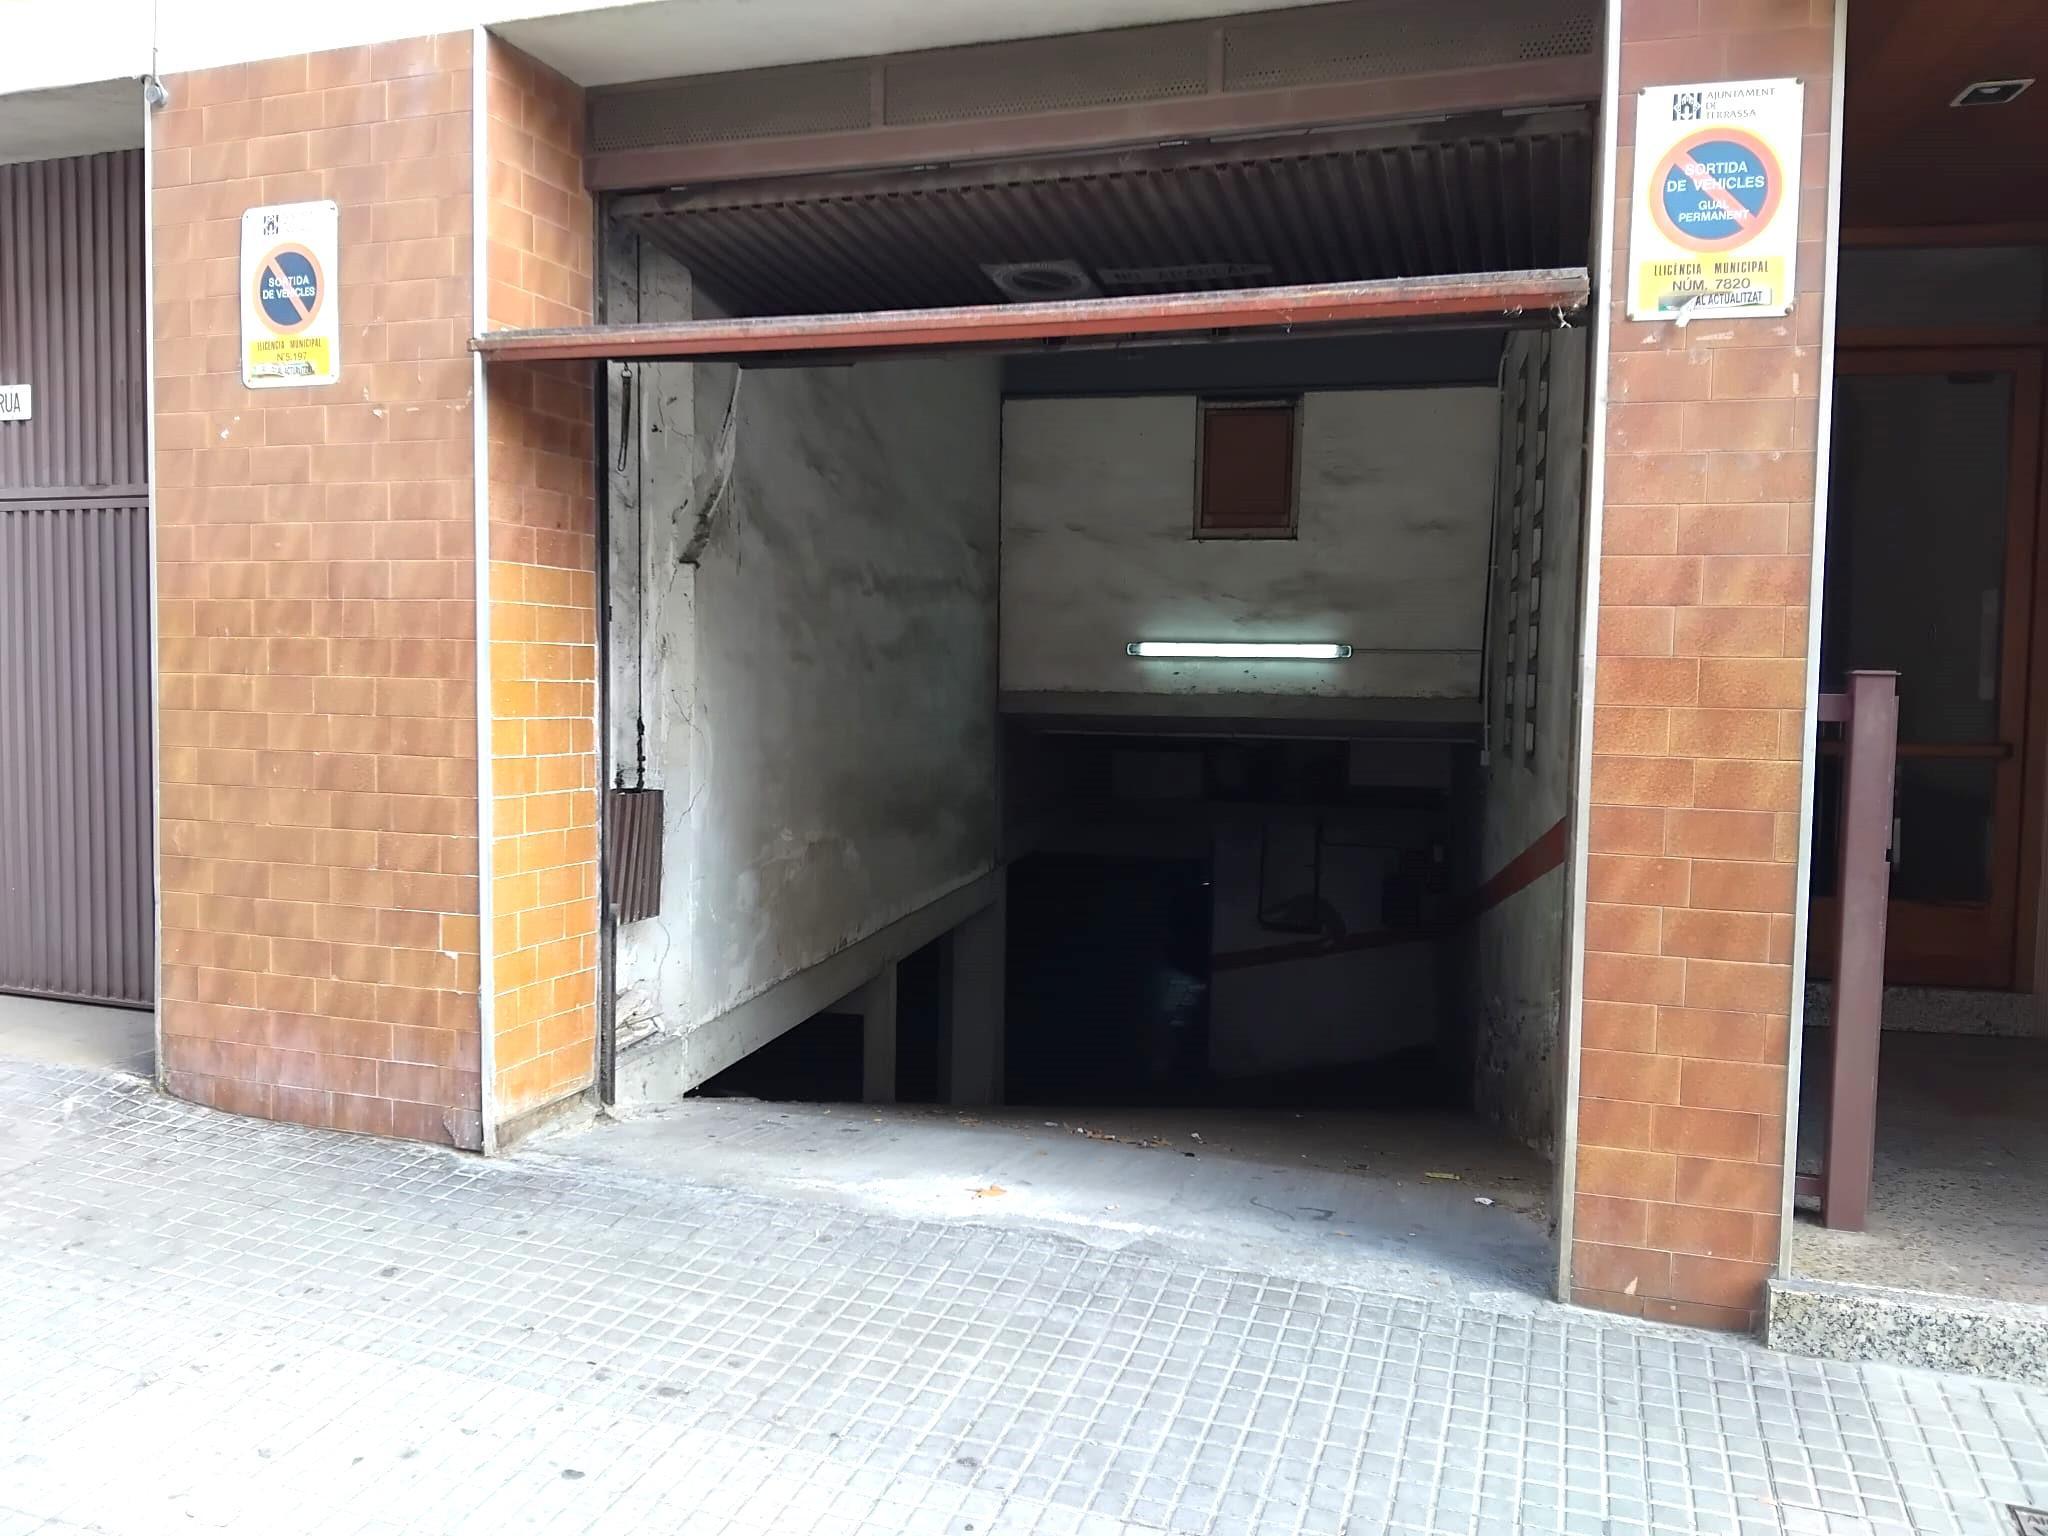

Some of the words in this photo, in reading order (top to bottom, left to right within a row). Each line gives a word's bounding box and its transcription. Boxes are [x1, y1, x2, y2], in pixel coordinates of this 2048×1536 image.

[1706, 87, 1776, 100] AJUNTAMENT
[1705, 108, 1757, 120] TERRASSA
[1684, 160, 1749, 176] SORTIDA
[1666, 179, 1687, 193] DE
[1693, 175, 1766, 191] VEHICLES
[1698, 200, 1730, 211] GUAL
[1678, 208, 1750, 222] PERMANENT
[1714, 260, 1770, 275] MUNICIPAL
[1672, 276, 1709, 291] NÚM.
[1715, 277, 1752, 290] 7820
[263, 288, 275, 300] DE
[1708, 290, 1764, 305] ACTUALITZAT
